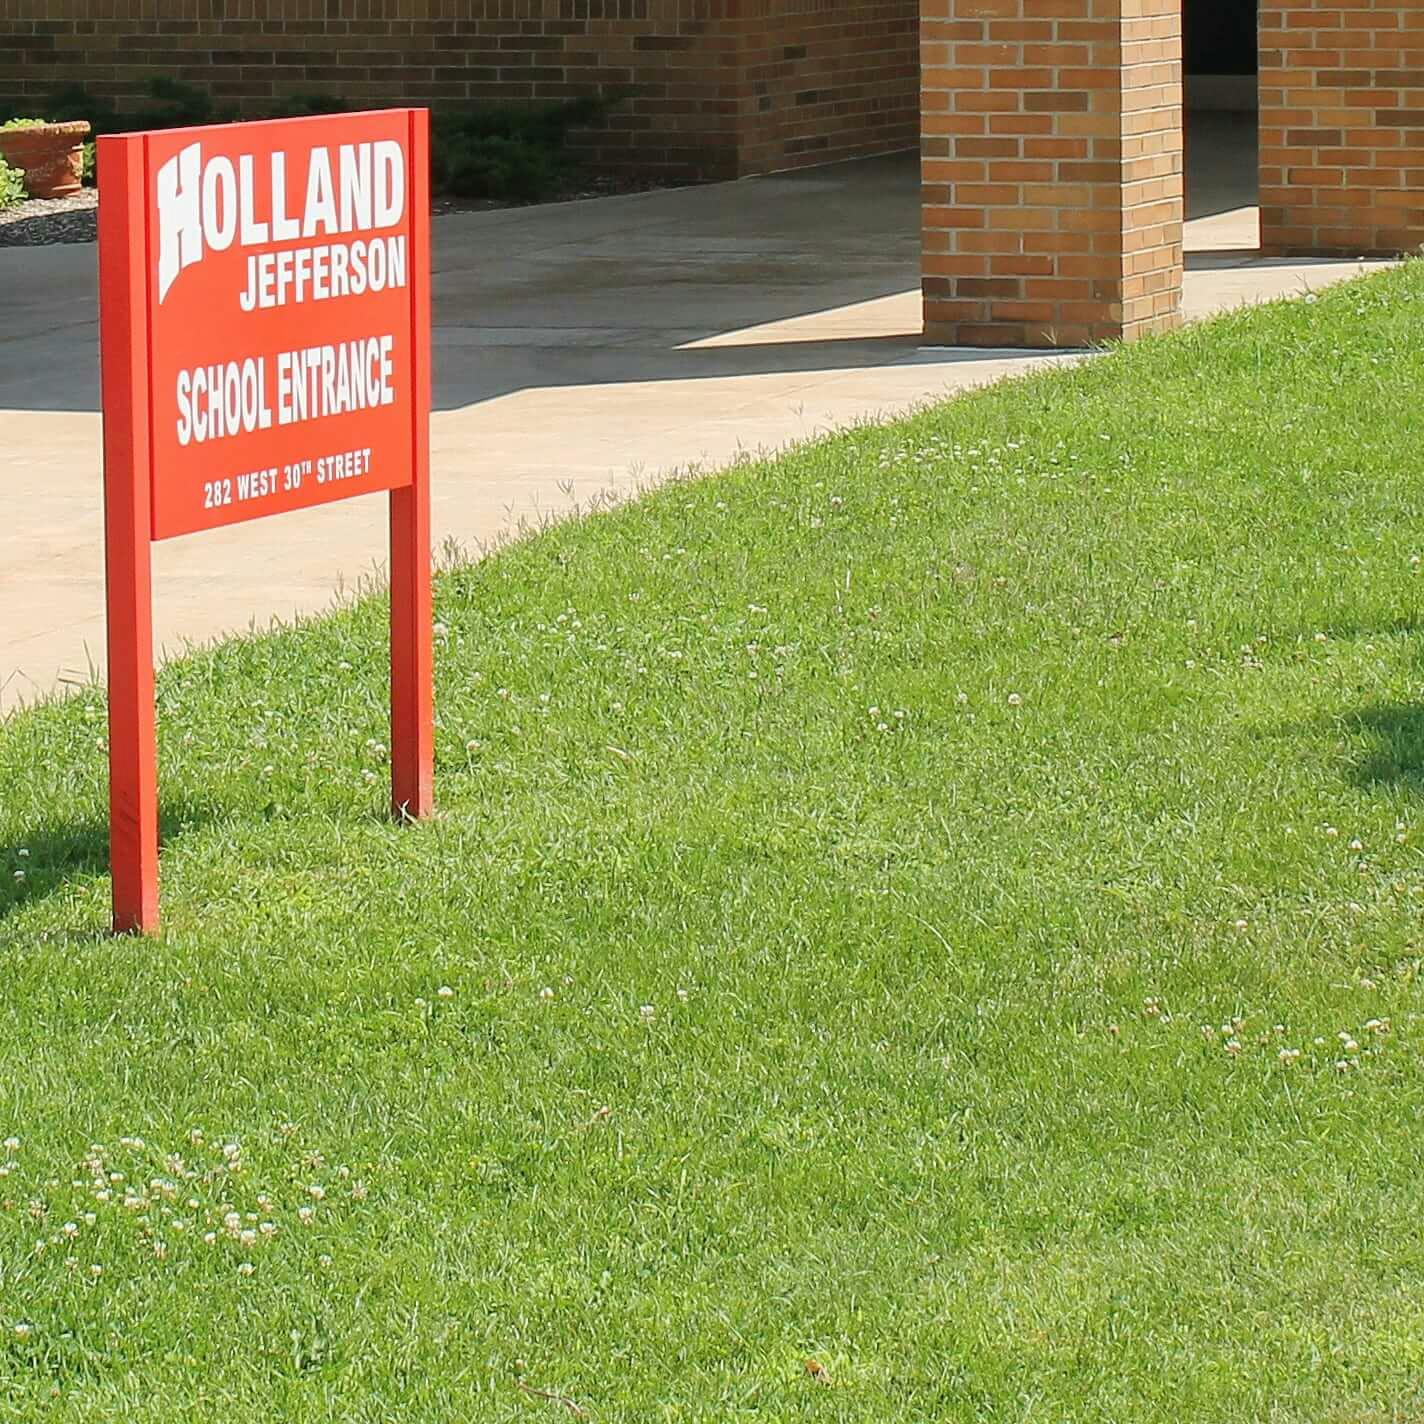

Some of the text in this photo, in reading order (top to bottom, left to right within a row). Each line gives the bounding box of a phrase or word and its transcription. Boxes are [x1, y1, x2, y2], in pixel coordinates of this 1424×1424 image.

[157, 139, 406, 305] HOLLAND
[239, 235, 407, 312] JEFFERSON
[176, 334, 394, 446] SCHOOL ENTRANCE
[203, 480, 232, 509] 282
[237, 467, 278, 501] WEST
[316, 447, 372, 484] STREET
